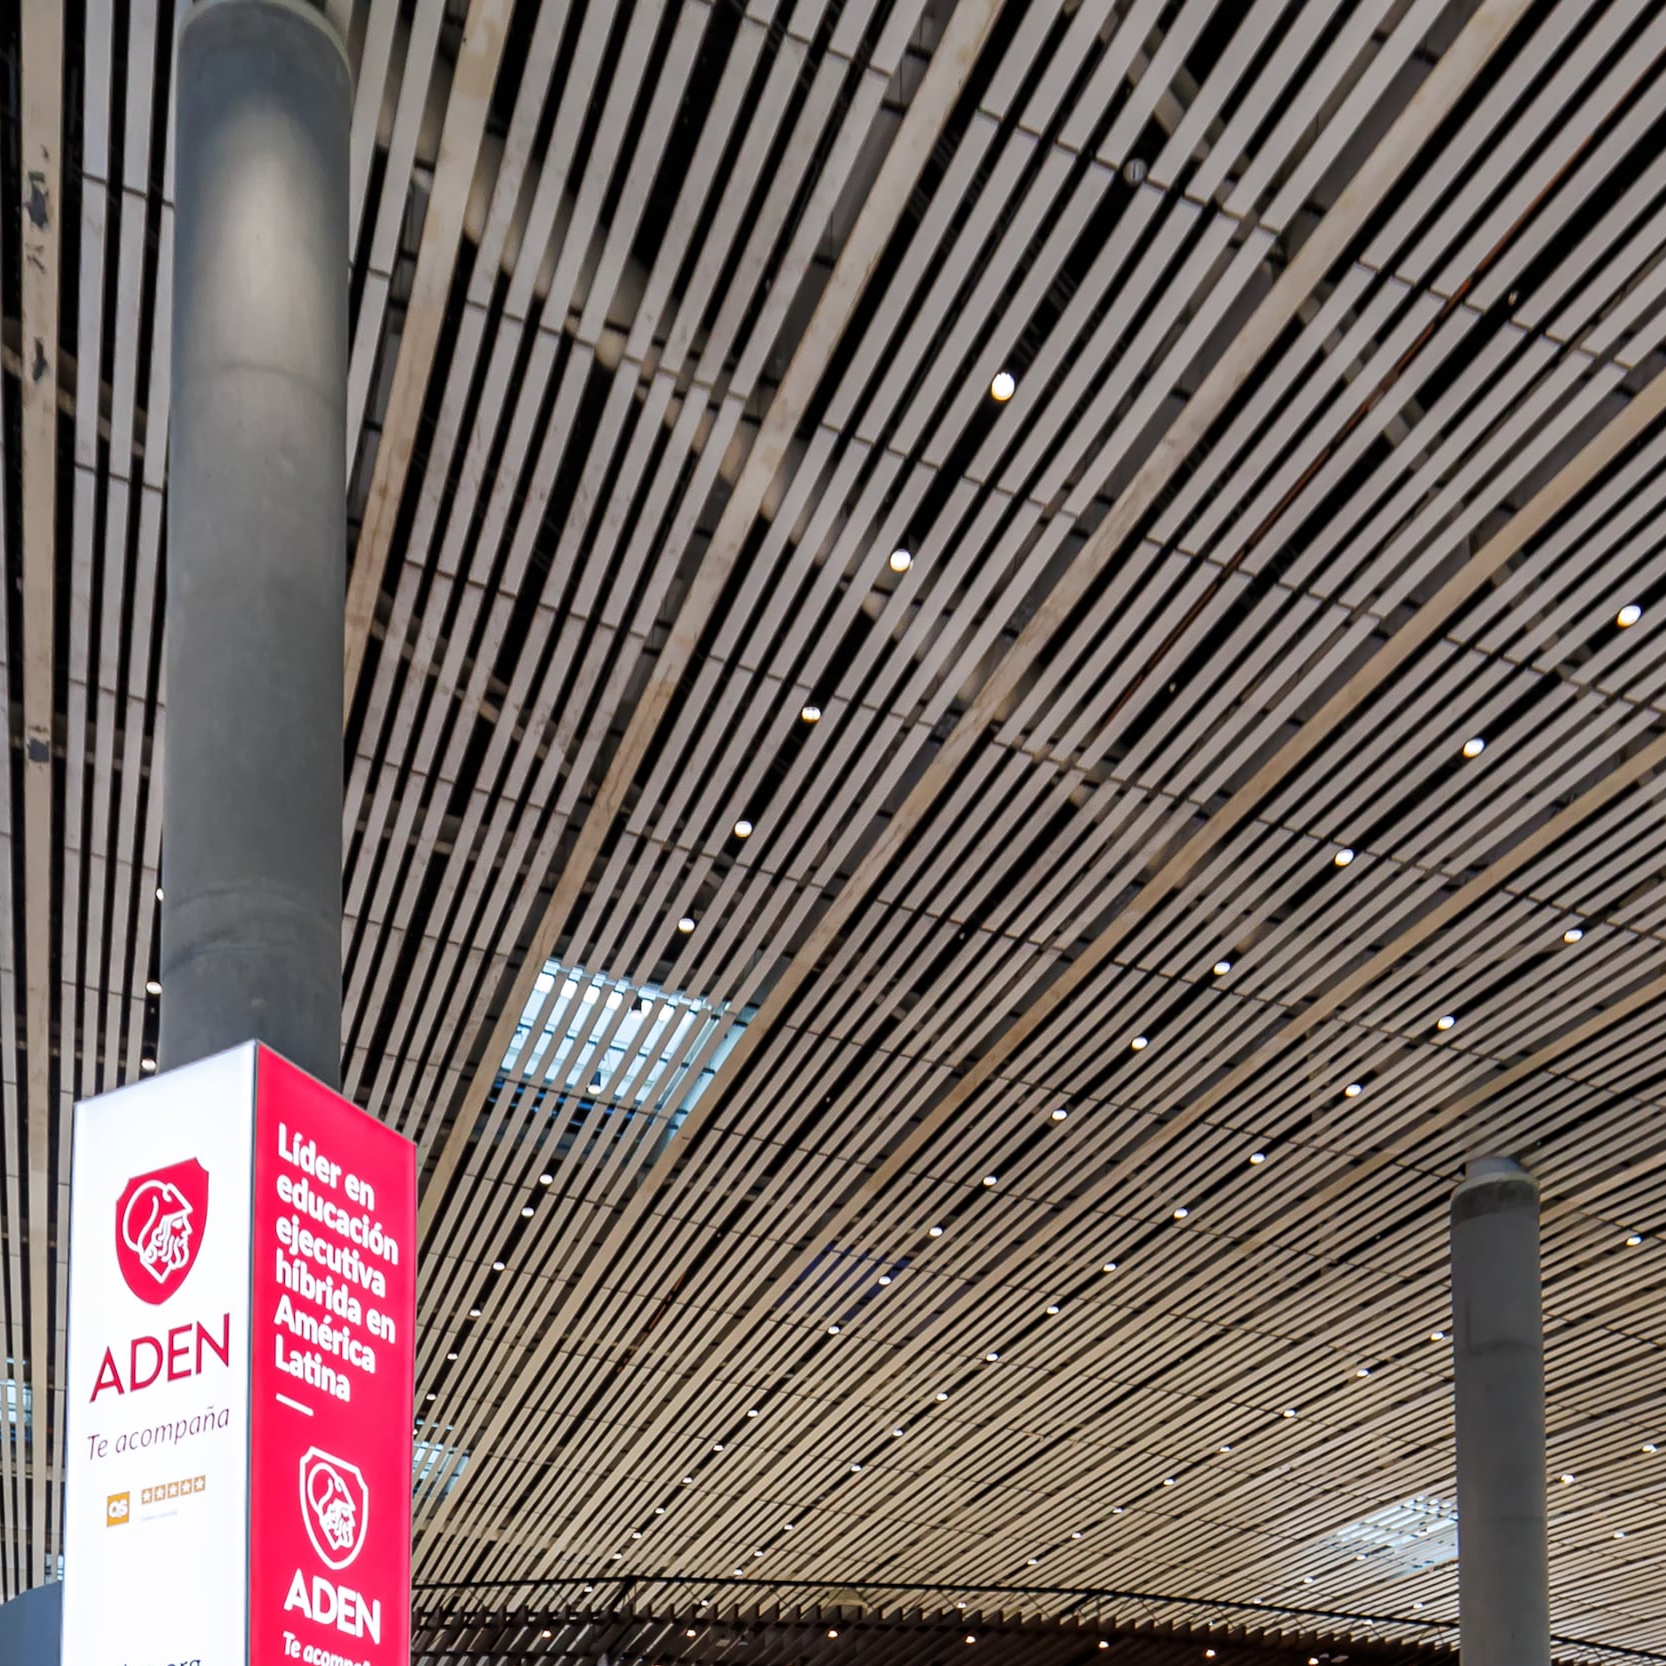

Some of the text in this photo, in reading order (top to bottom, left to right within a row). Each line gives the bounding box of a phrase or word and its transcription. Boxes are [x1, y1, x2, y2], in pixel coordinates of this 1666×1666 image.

[278, 1121, 375, 1211] Líder en
[276, 1174, 399, 1266] educación
[276, 1214, 386, 1298] ejecutiva
[274, 1293, 376, 1374] América
[276, 1247, 396, 1344] híbrida en
[89, 1312, 230, 1404] ADEN
[275, 1333, 351, 1403] Latina
[87, 1405, 230, 1461] Te acompaña
[283, 1629, 302, 1659] Te
[284, 1567, 381, 1646] ADEN
